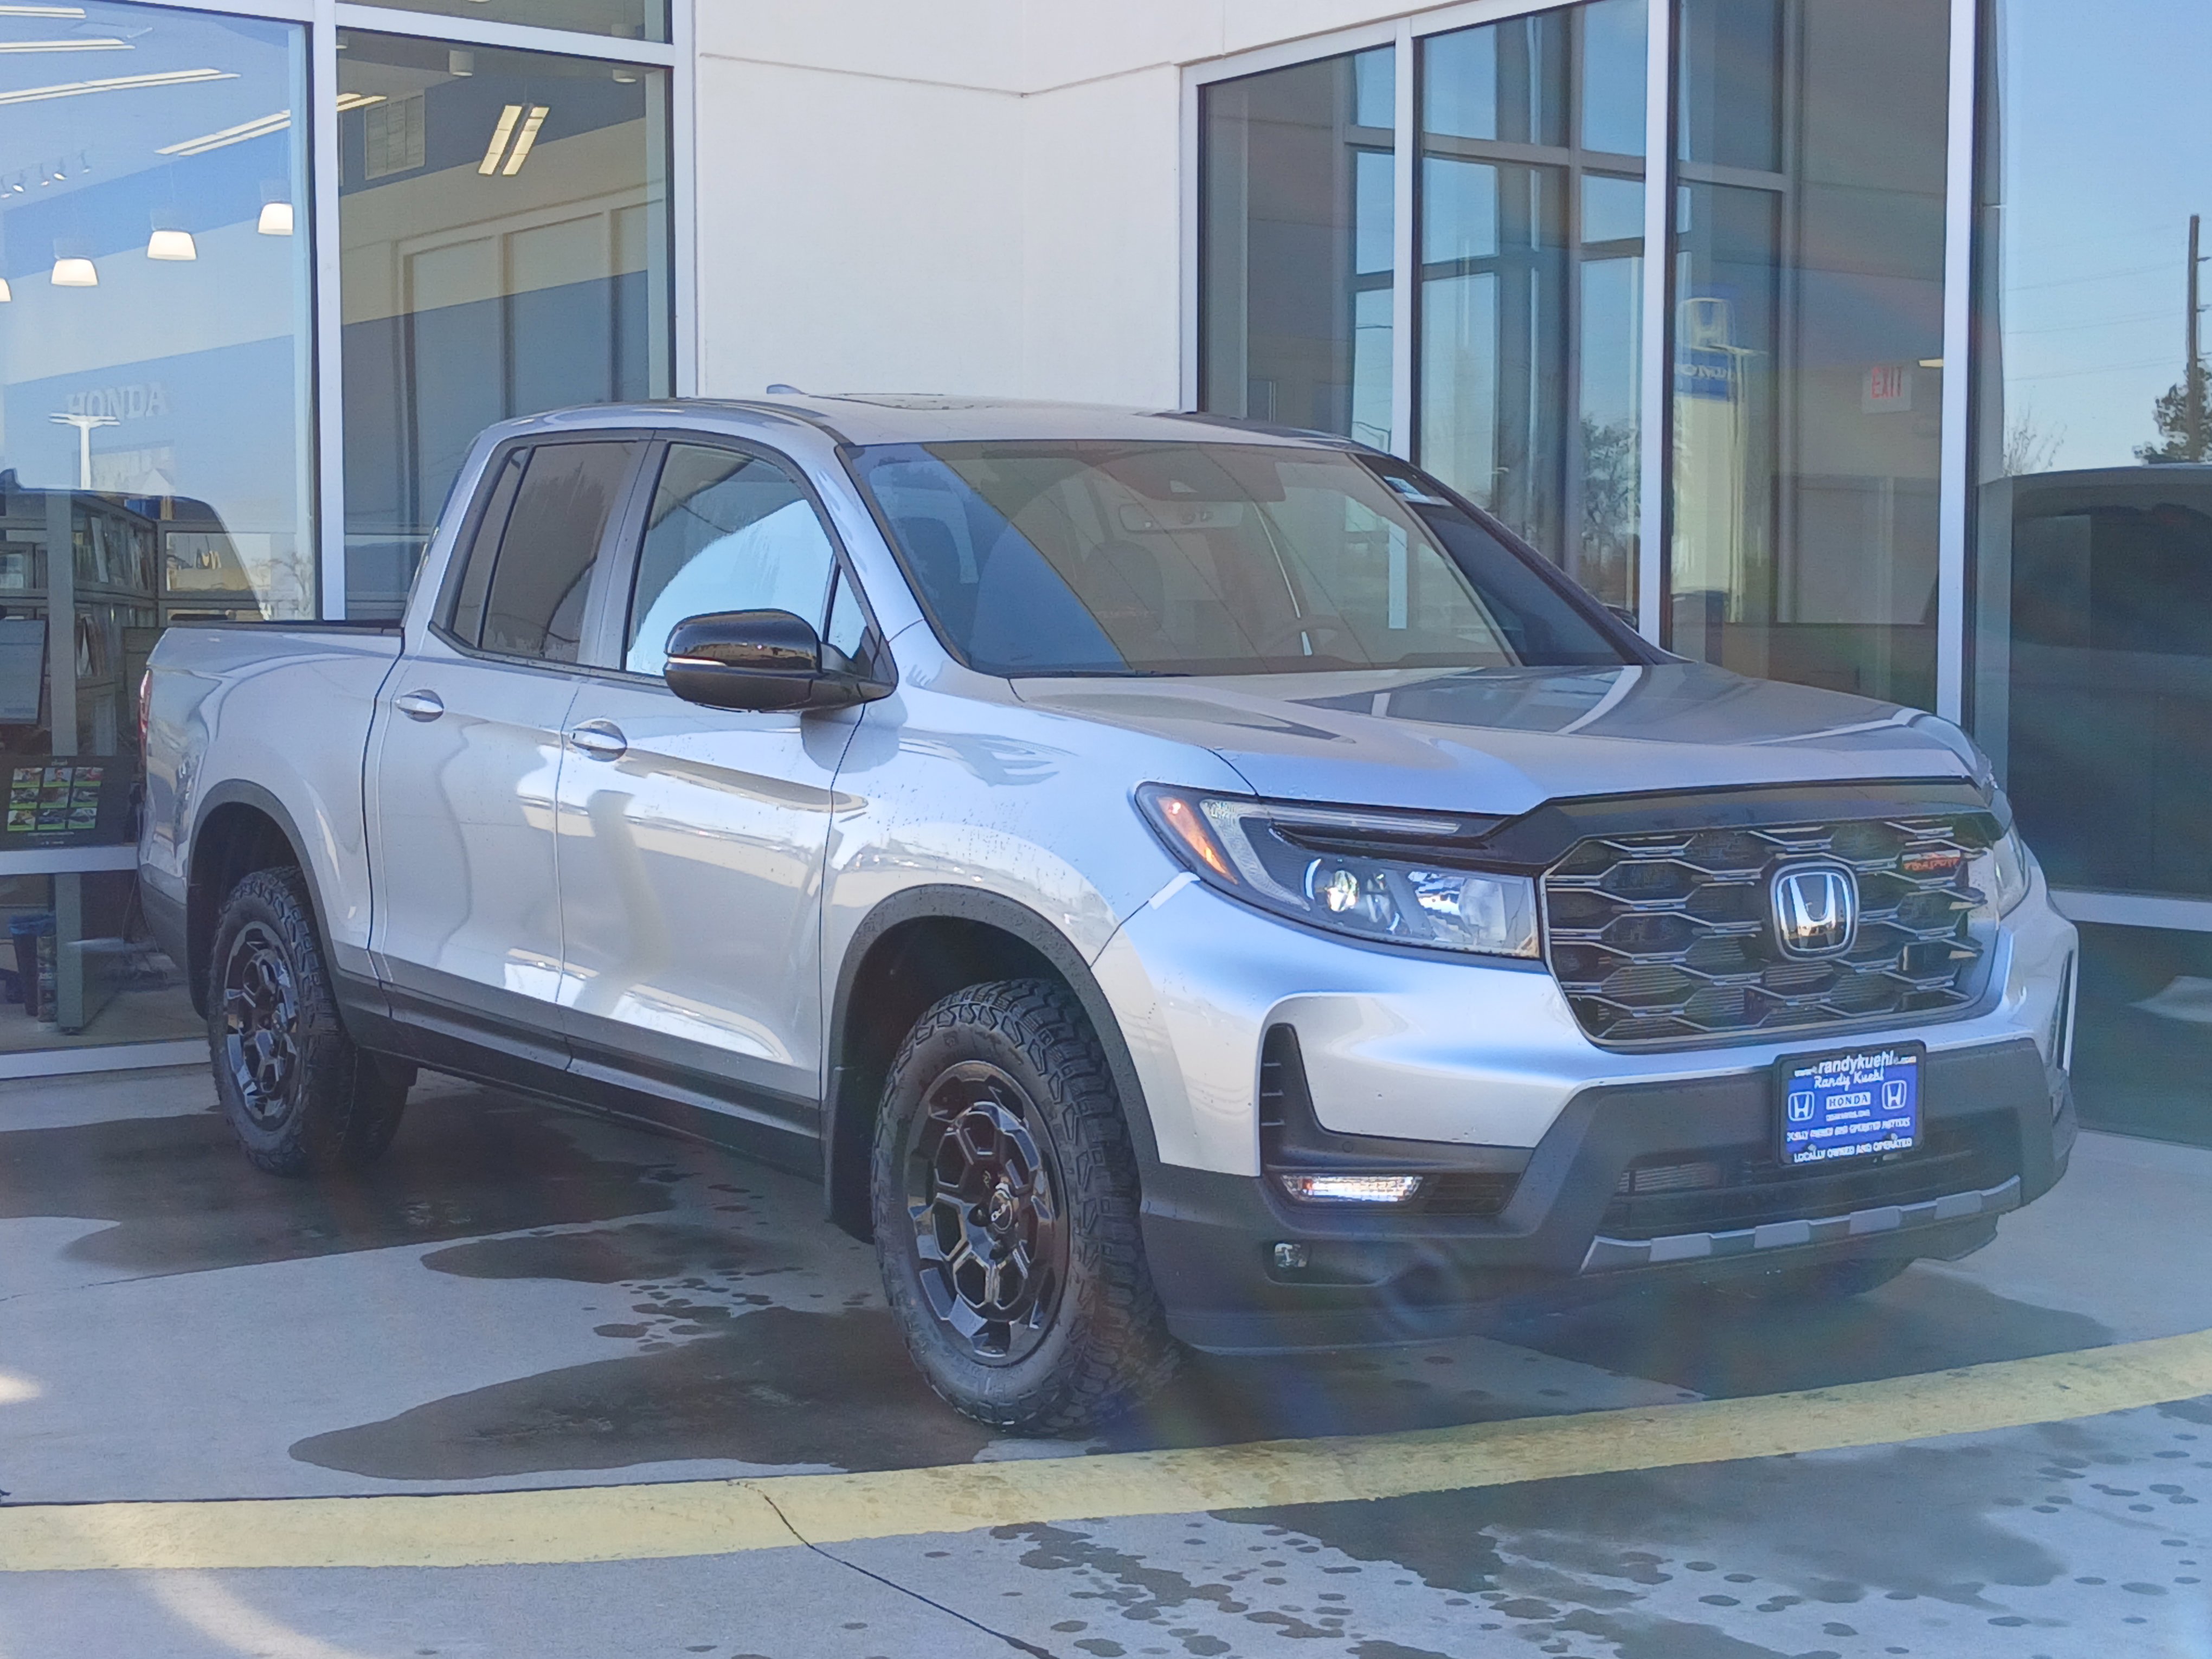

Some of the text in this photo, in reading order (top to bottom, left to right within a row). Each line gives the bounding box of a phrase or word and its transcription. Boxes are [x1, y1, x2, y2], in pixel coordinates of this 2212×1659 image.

[1871, 366, 1904, 399] EXIT
[66, 381, 168, 419] HONDA
[1814, 1069, 1884, 1091] Randy Kuehl
[1829, 1095, 1868, 1107] HONDA
[1794, 1148, 1825, 1163] LOCALLY
